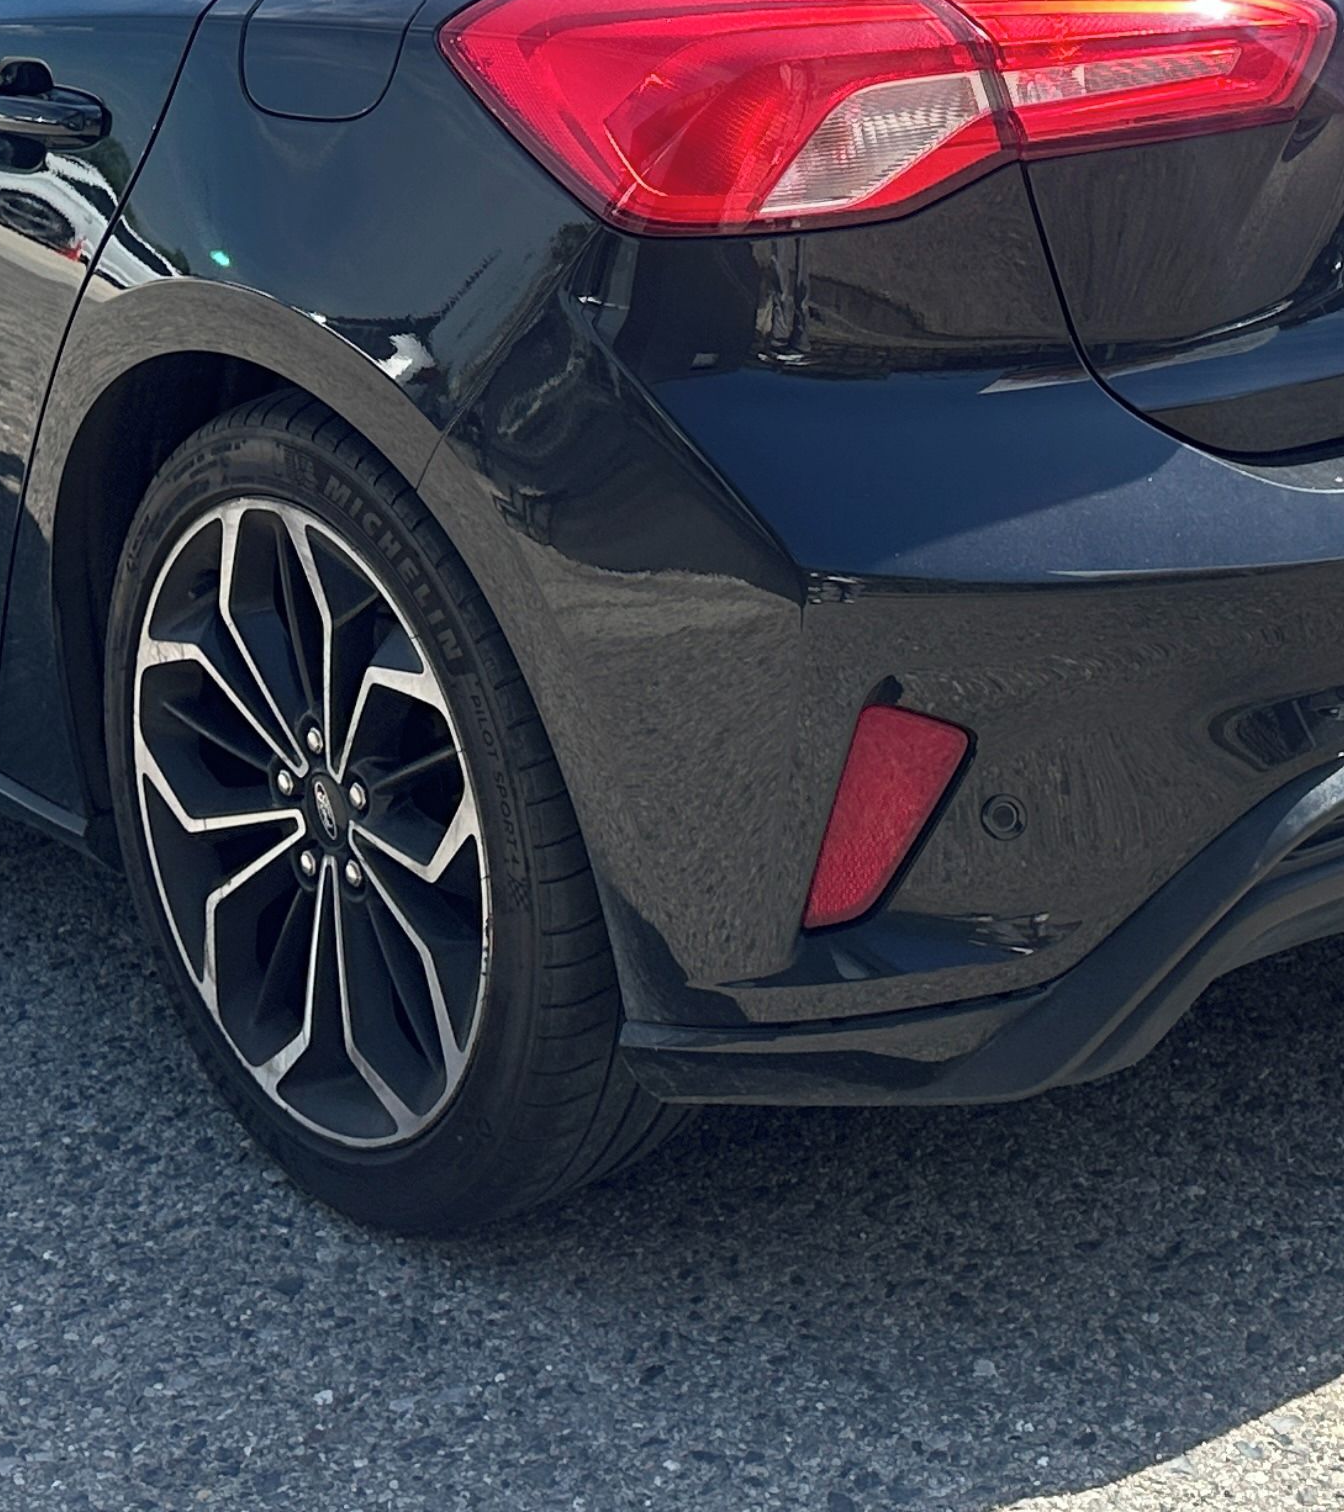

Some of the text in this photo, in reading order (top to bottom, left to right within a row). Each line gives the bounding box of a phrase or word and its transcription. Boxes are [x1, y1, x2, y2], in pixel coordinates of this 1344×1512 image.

[323, 475, 463, 662] MICHELIN
[470, 694, 499, 761] PILOT
[494, 771, 518, 851] SPORT
